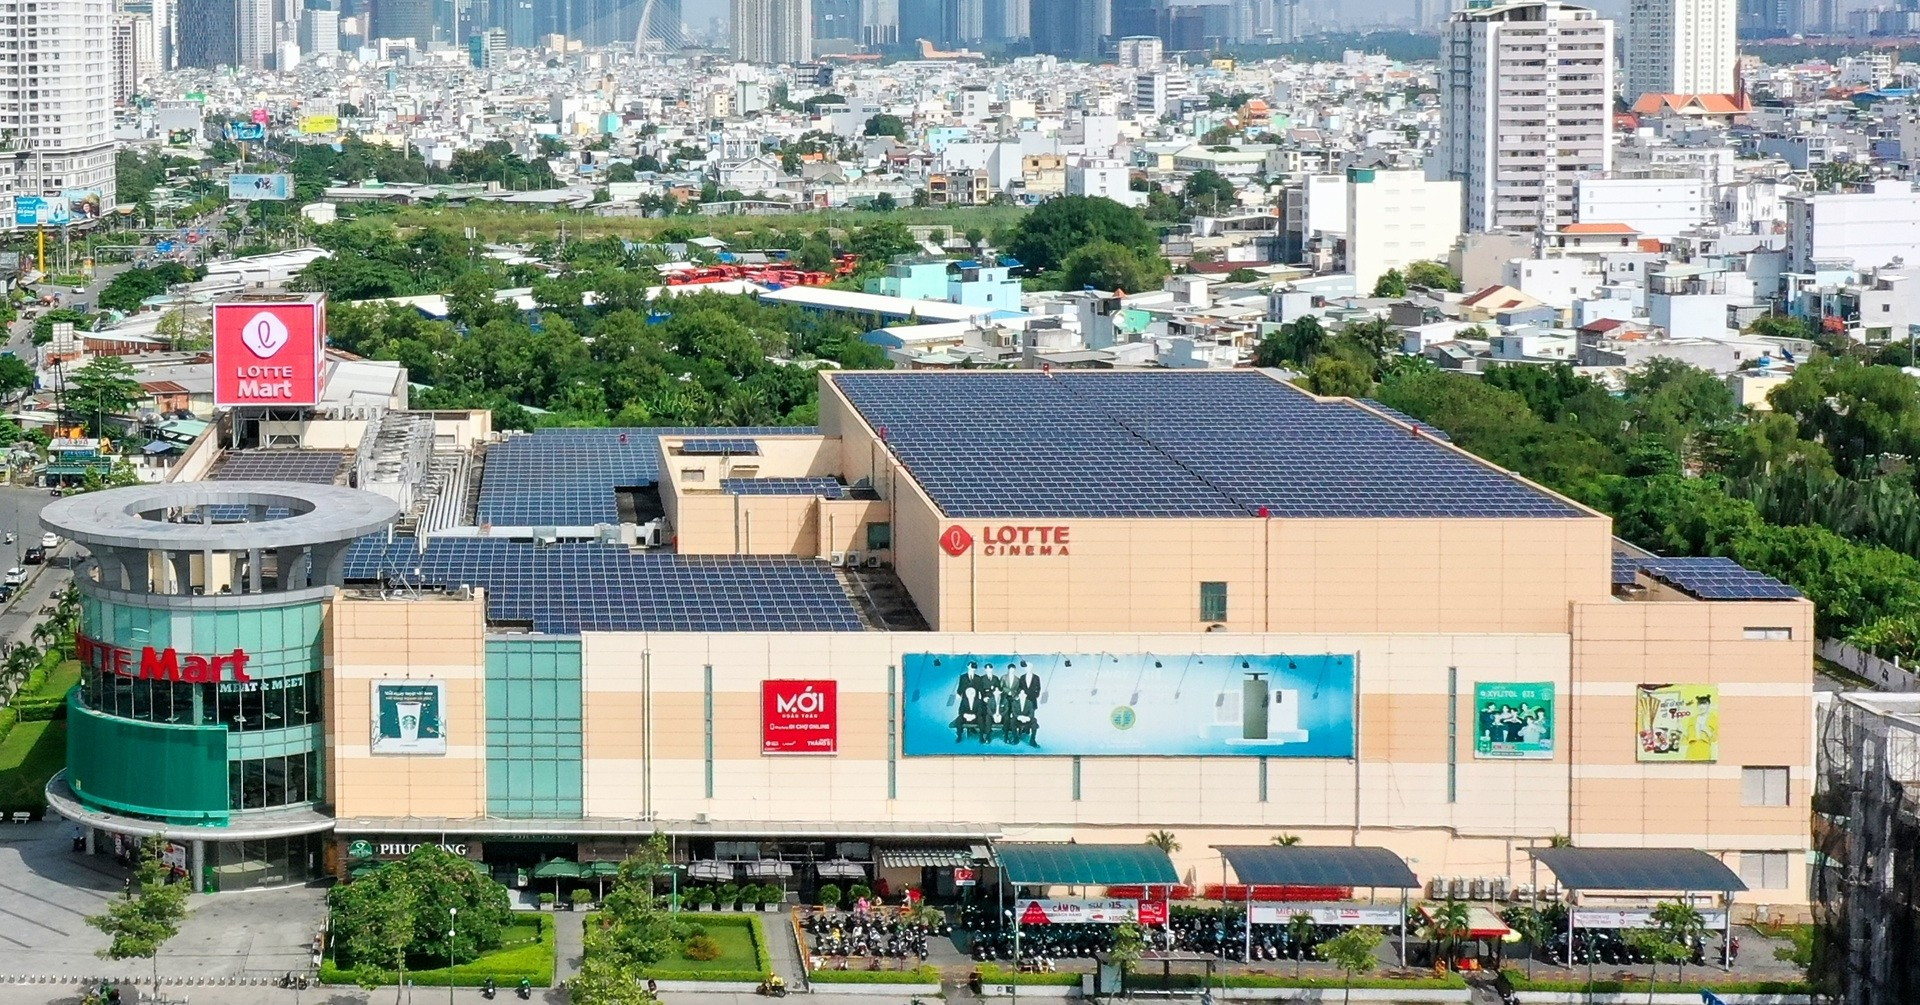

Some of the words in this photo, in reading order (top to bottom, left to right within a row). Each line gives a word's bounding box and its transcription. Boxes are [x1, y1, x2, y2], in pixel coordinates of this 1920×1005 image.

[237, 366, 292, 378] LOTTE
[237, 380, 292, 398] Mart
[984, 526, 1070, 544] LOTTE
[984, 545, 1069, 556] CINEMA
[139, 646, 250, 683] Mart
[220, 682, 258, 692] MEAT
